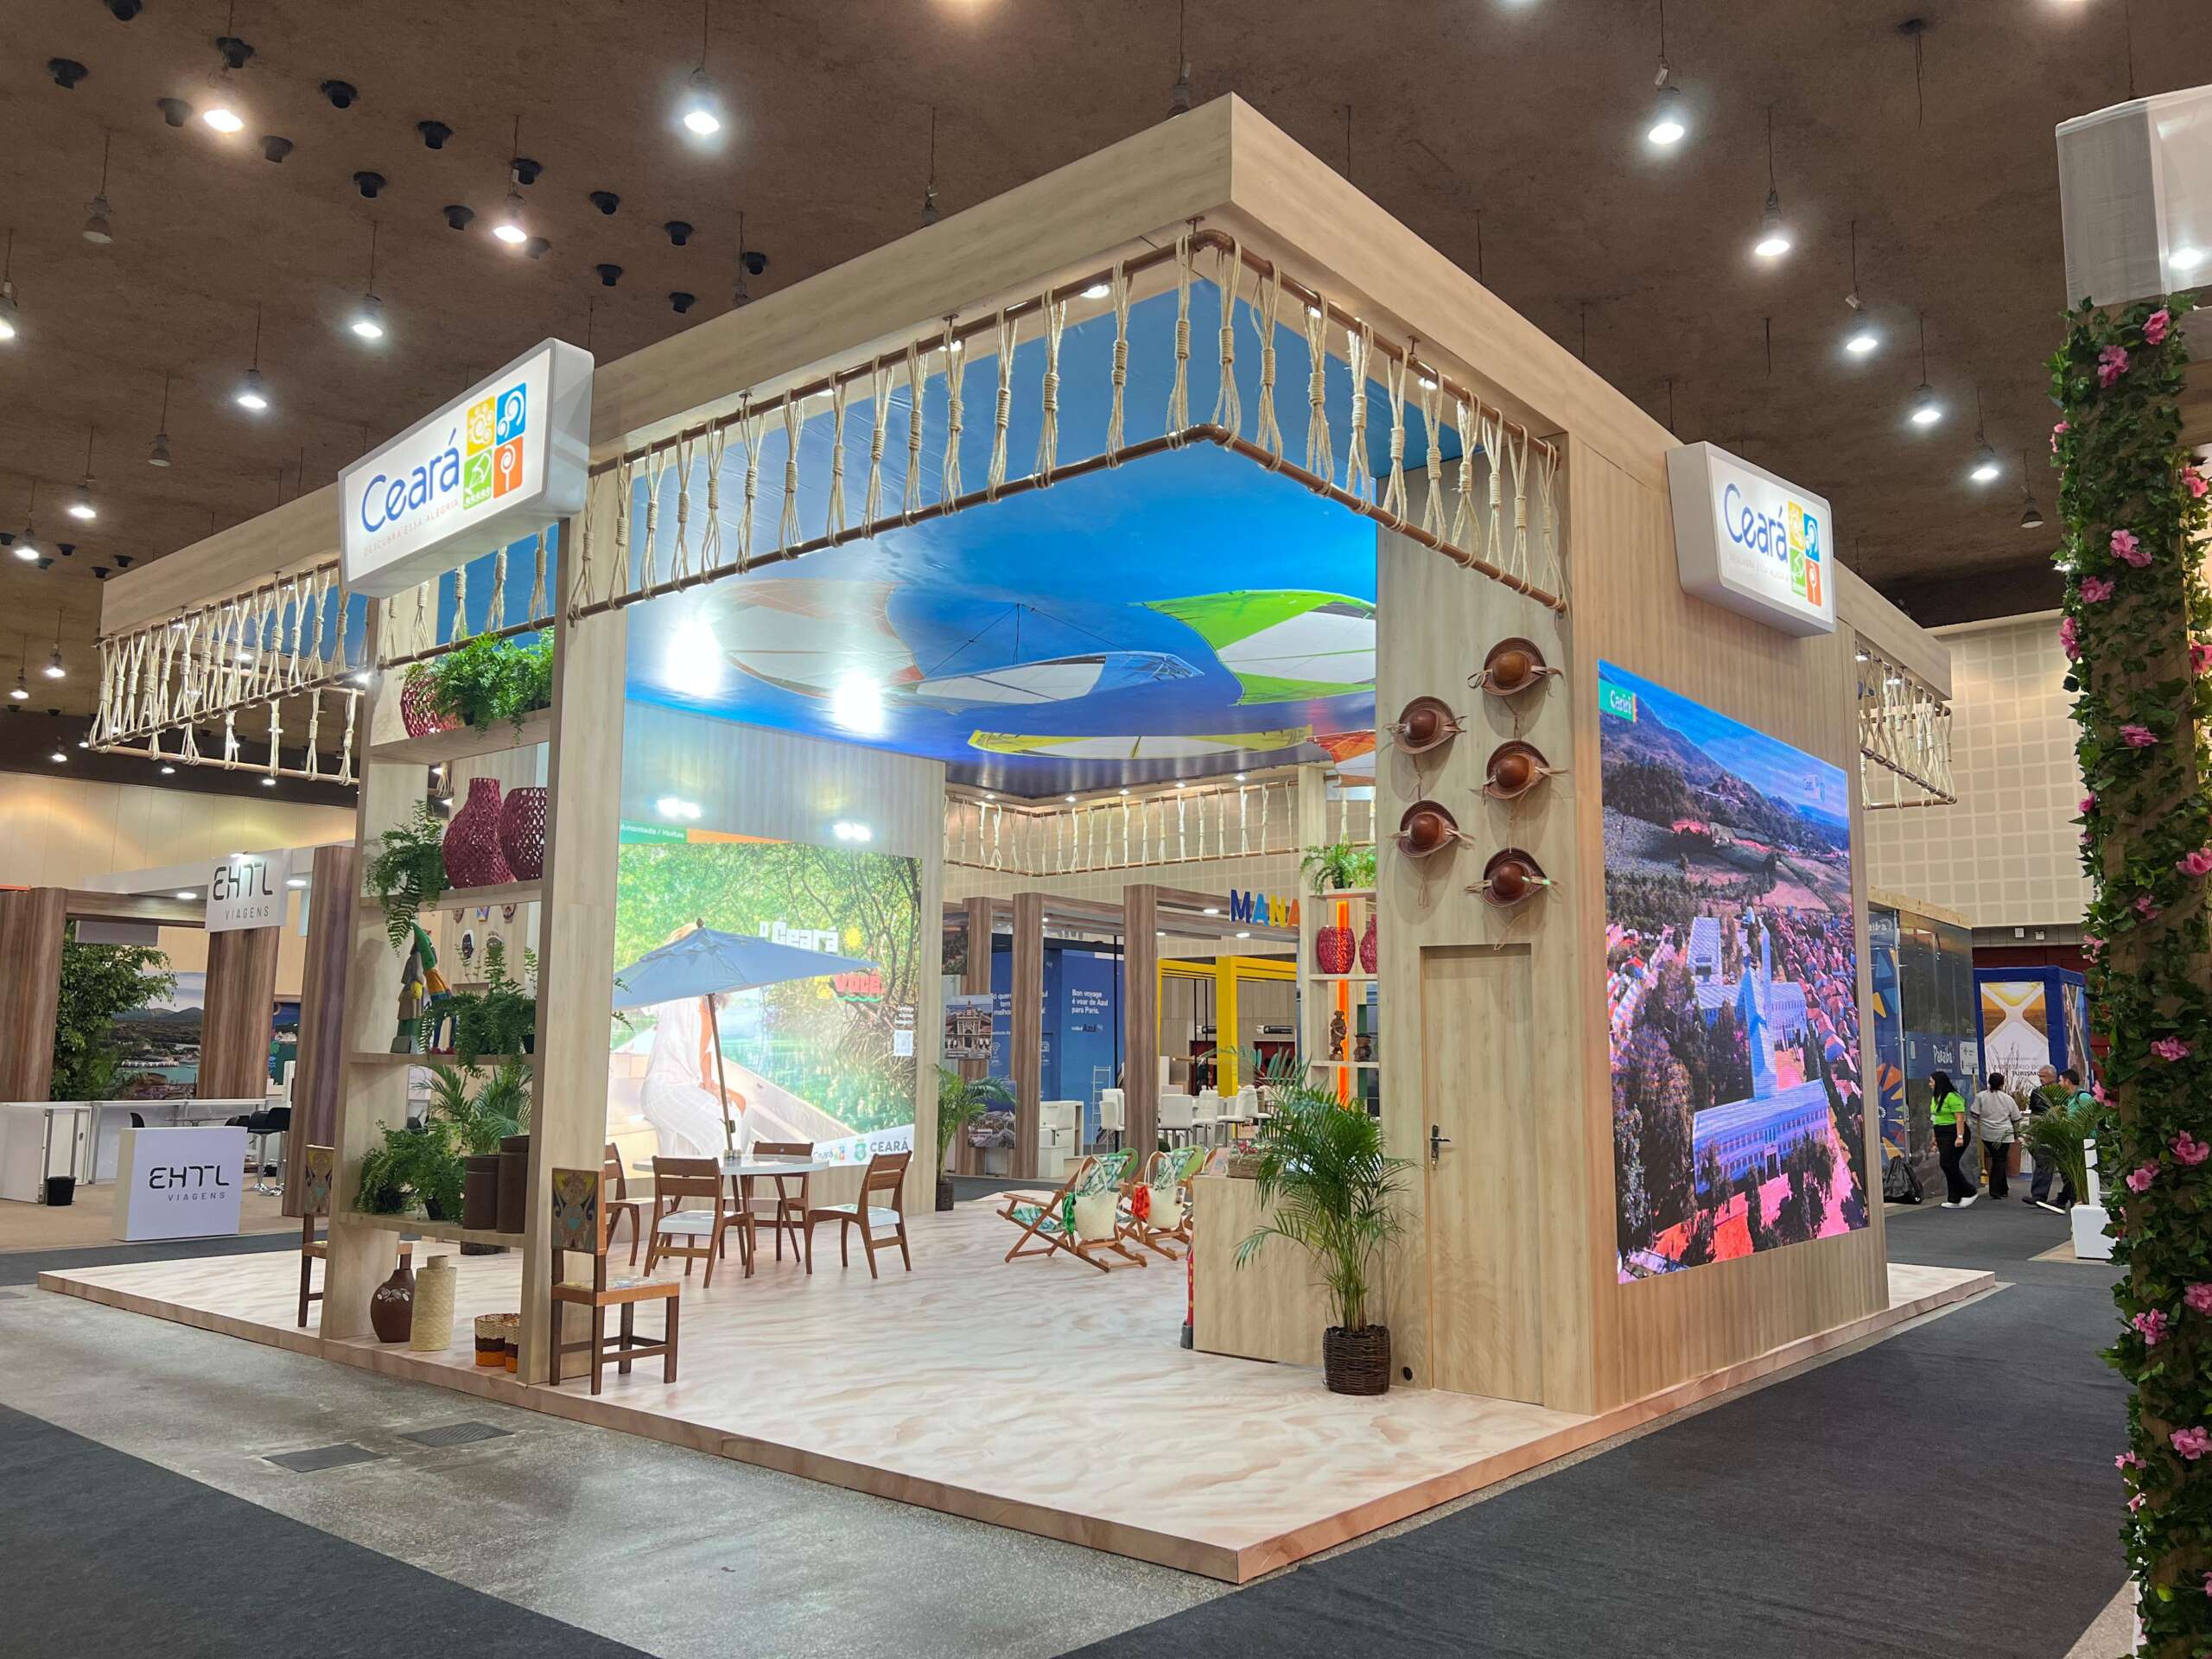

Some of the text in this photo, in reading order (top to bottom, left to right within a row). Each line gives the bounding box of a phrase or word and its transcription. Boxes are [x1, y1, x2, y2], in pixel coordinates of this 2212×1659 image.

[361, 428, 460, 532] Ceará
[1724, 483, 1789, 563] Ceará
[213, 861, 273, 900] EHTL
[225, 906, 270, 920] VIAGENS
[870, 1137, 908, 1153] CEARÁ
[149, 1165, 230, 1189] EHTL
[168, 1192, 226, 1202] VIAGENS
